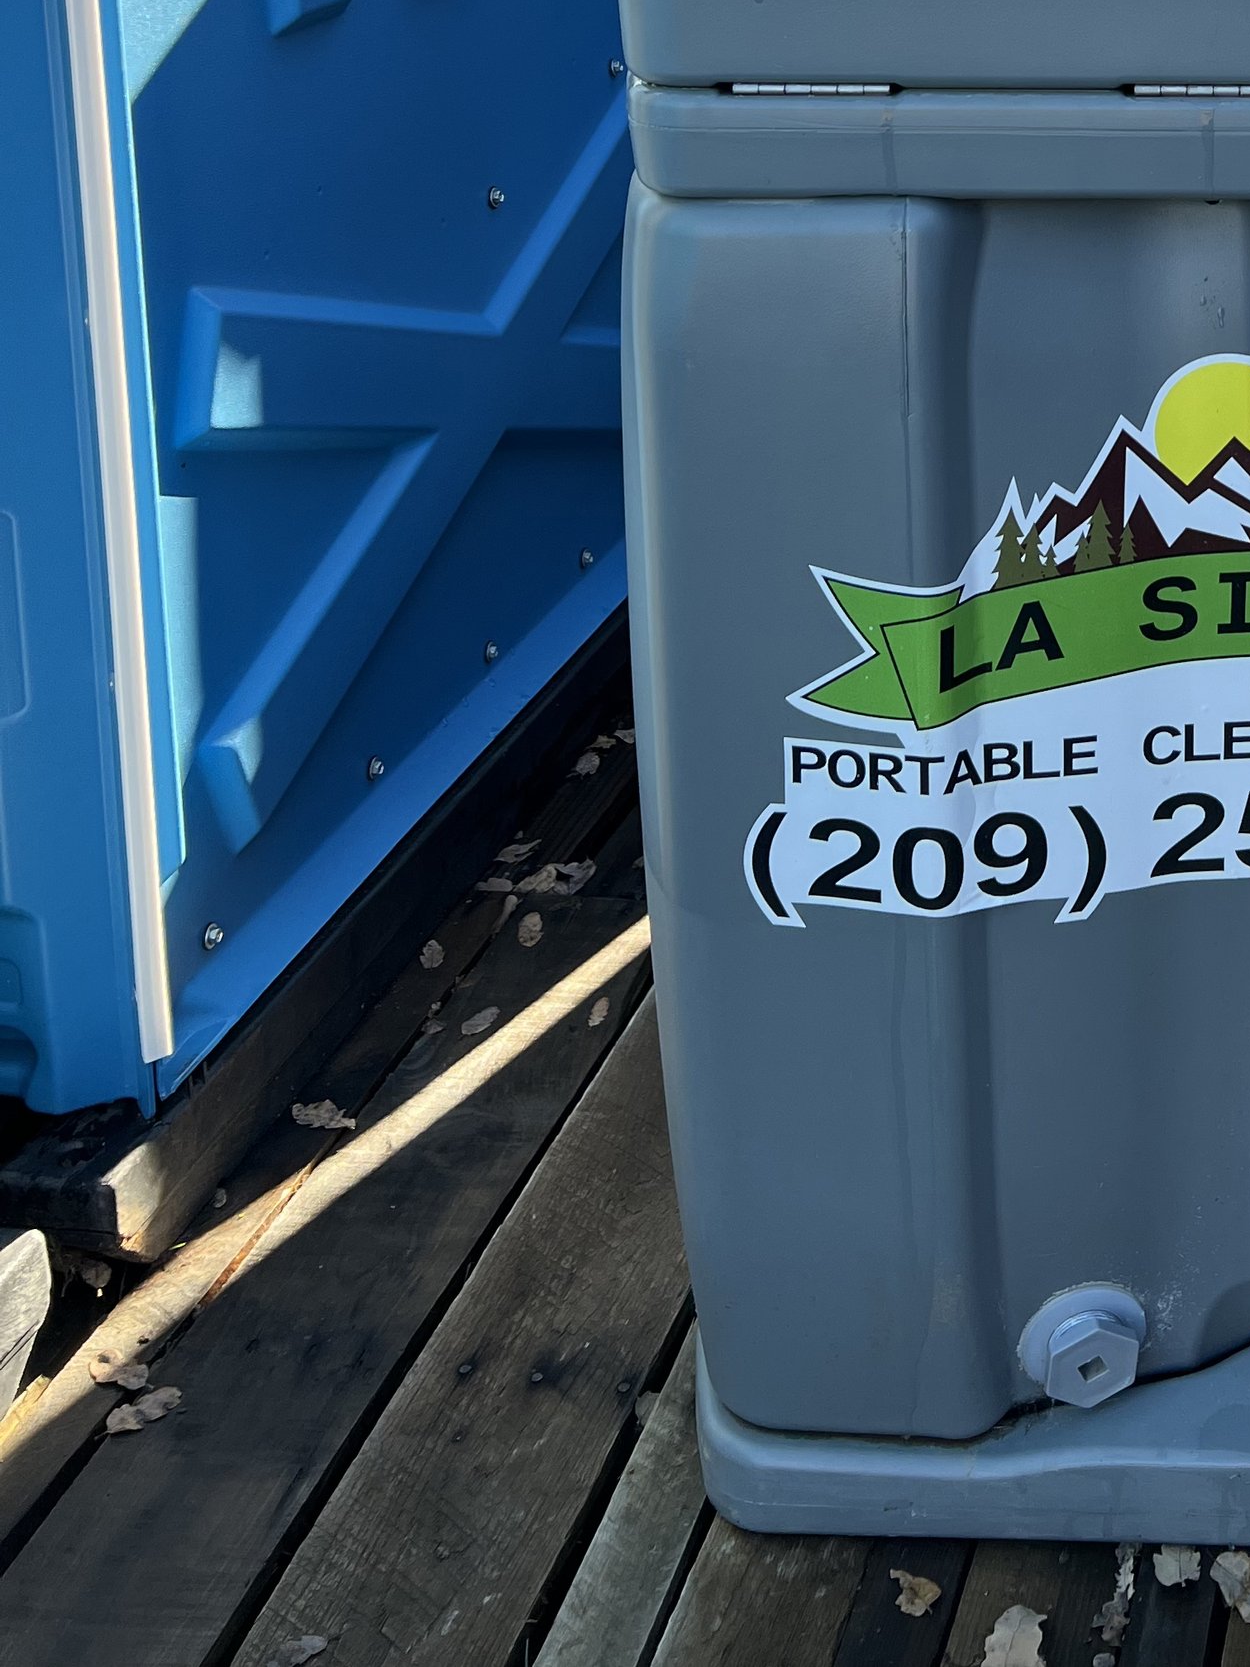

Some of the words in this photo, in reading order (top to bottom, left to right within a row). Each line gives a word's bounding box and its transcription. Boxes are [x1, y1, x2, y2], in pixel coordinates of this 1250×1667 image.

[938, 600, 1065, 694] LA
[791, 736, 1099, 795] PORTABLE
[750, 806, 1107, 917] (209)
